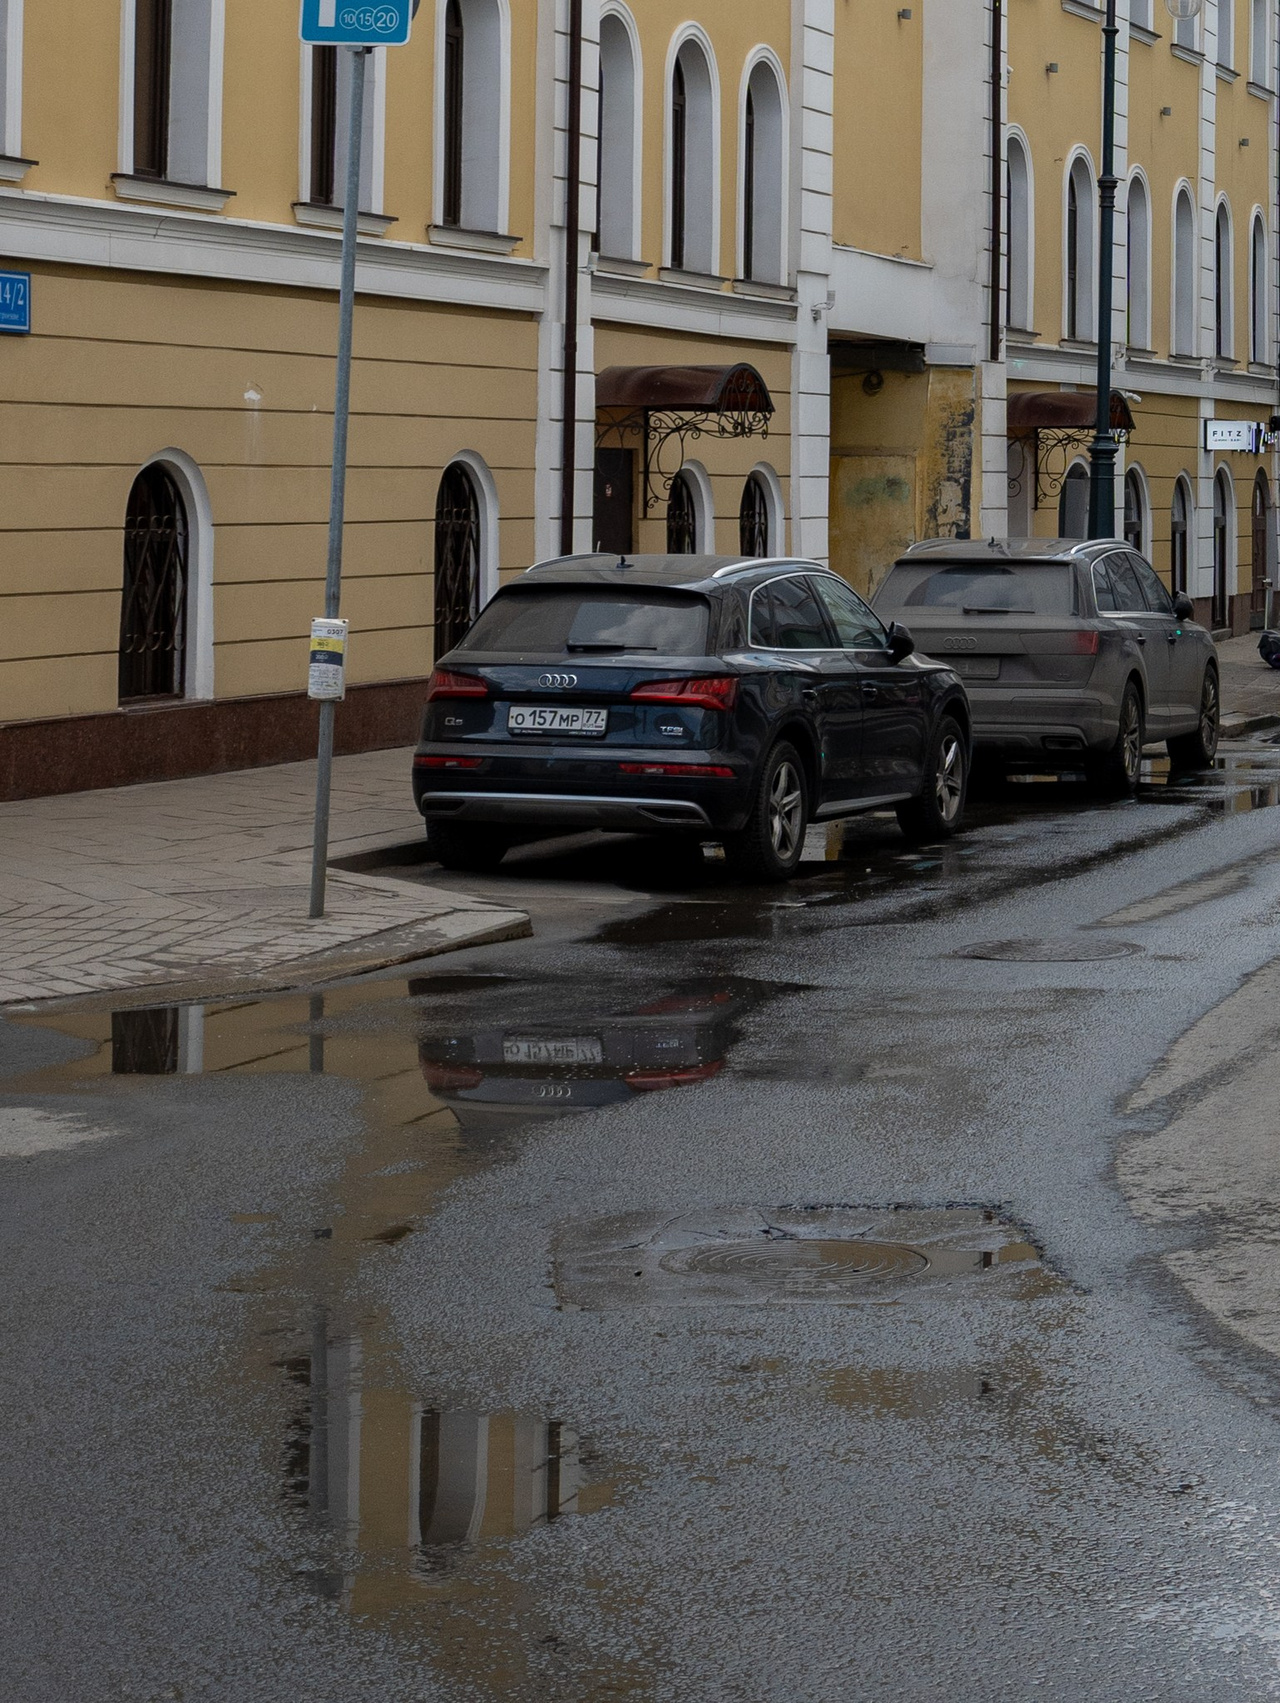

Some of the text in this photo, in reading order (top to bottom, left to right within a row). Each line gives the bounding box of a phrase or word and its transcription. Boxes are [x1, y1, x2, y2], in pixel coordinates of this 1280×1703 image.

[343, 12, 396, 27] 10 15 20
[445, 717, 463, 726] Q5
[586, 710, 601, 724] 77
